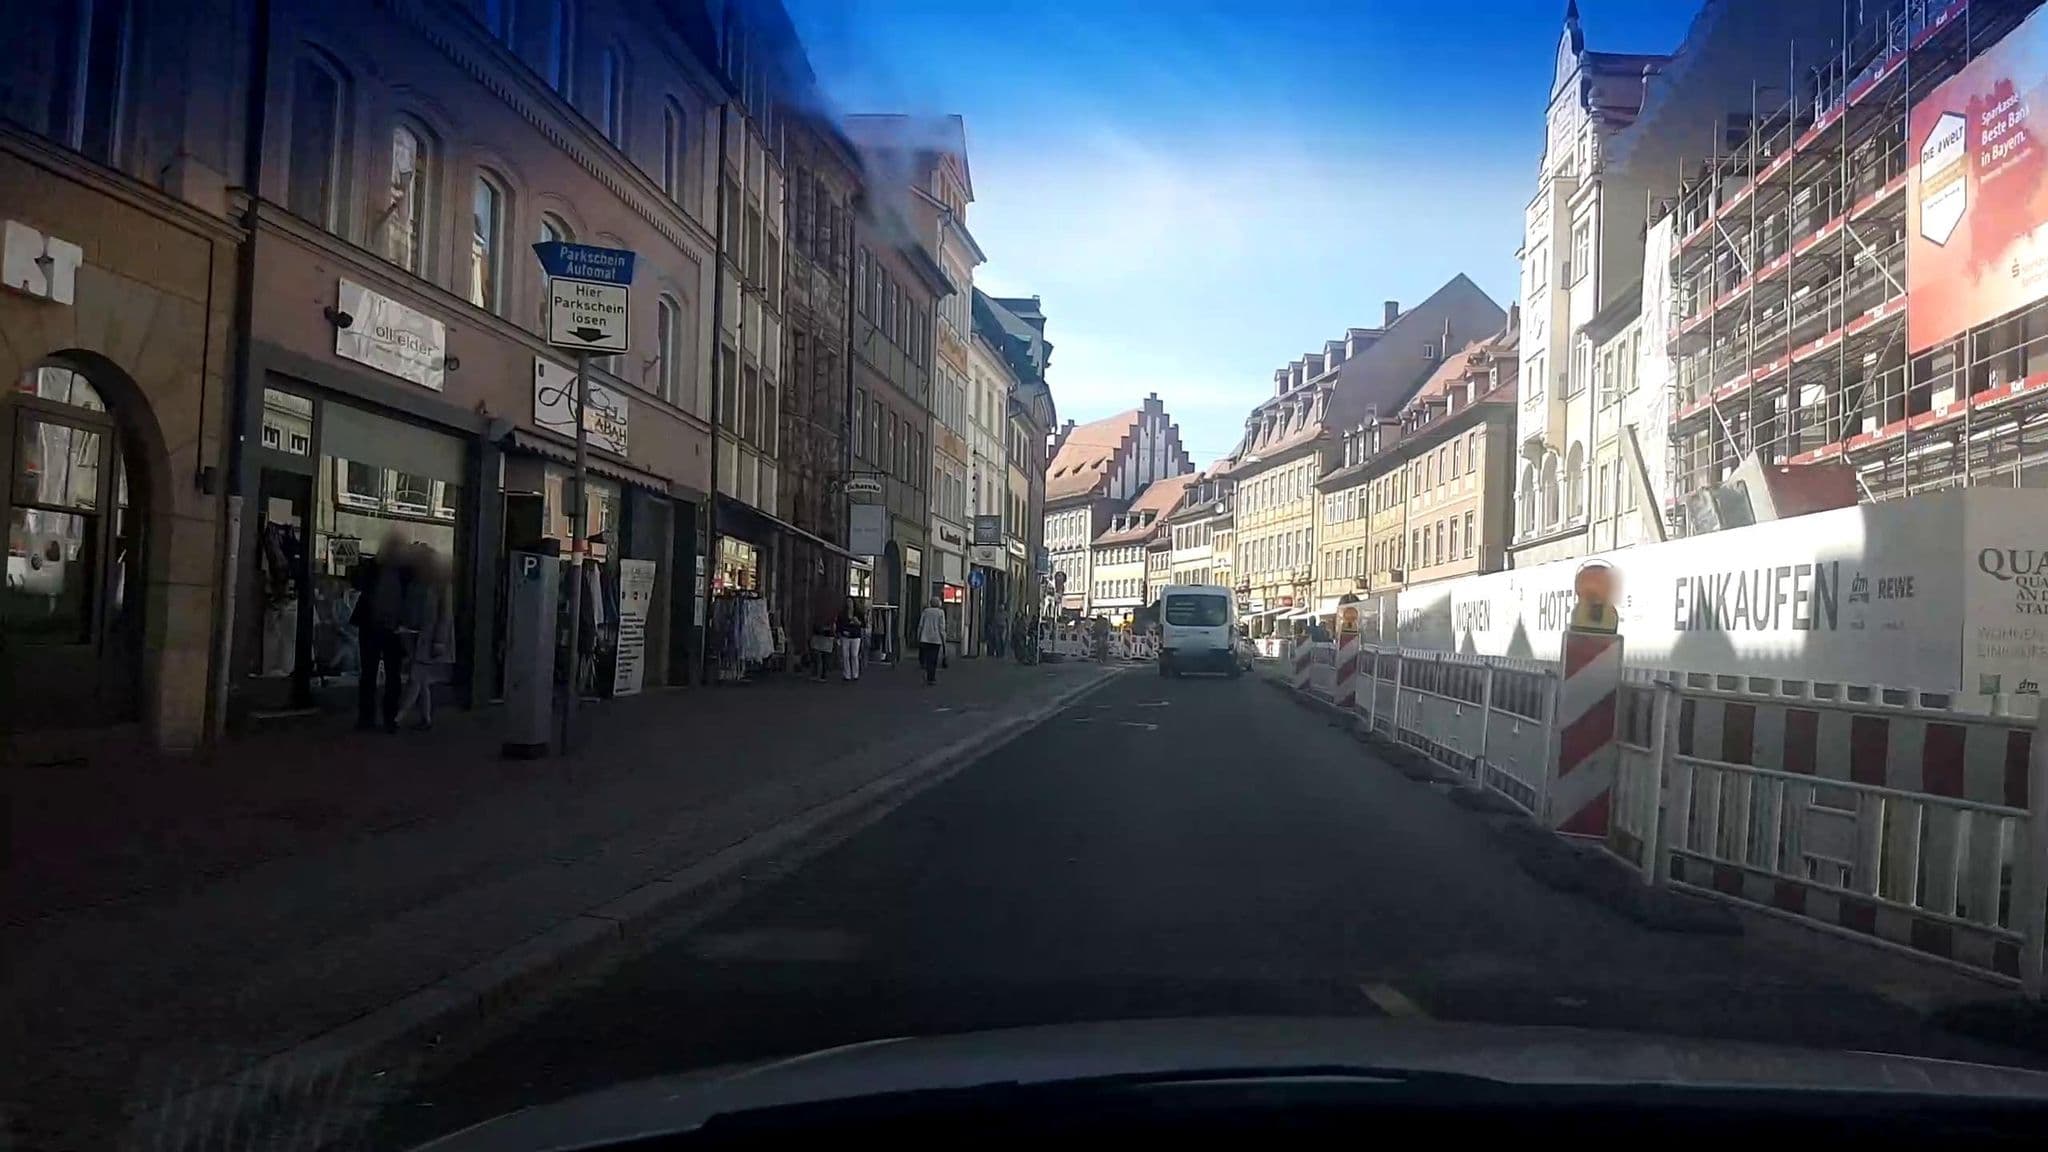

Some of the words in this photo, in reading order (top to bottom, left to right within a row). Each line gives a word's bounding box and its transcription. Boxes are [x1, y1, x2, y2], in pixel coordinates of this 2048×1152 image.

[1981, 124, 2007, 146] Beste
[1923, 146, 1934, 164] DIE
[1981, 151, 1991, 167] in
[1992, 131, 2026, 159] Bayern.
[560, 246, 625, 267] Parkschein
[566, 262, 616, 280] Automat
[576, 285, 603, 298] Hier
[554, 296, 624, 314] Parkschein
[524, 556, 538, 576] P
[1674, 560, 1839, 631] EINKAUFEN
[1878, 576, 1914, 600] REWE
[1456, 600, 1490, 631] WOHNEN
[1539, 589, 1575, 631] HOTE
[2018, 678, 2039, 690] dm
